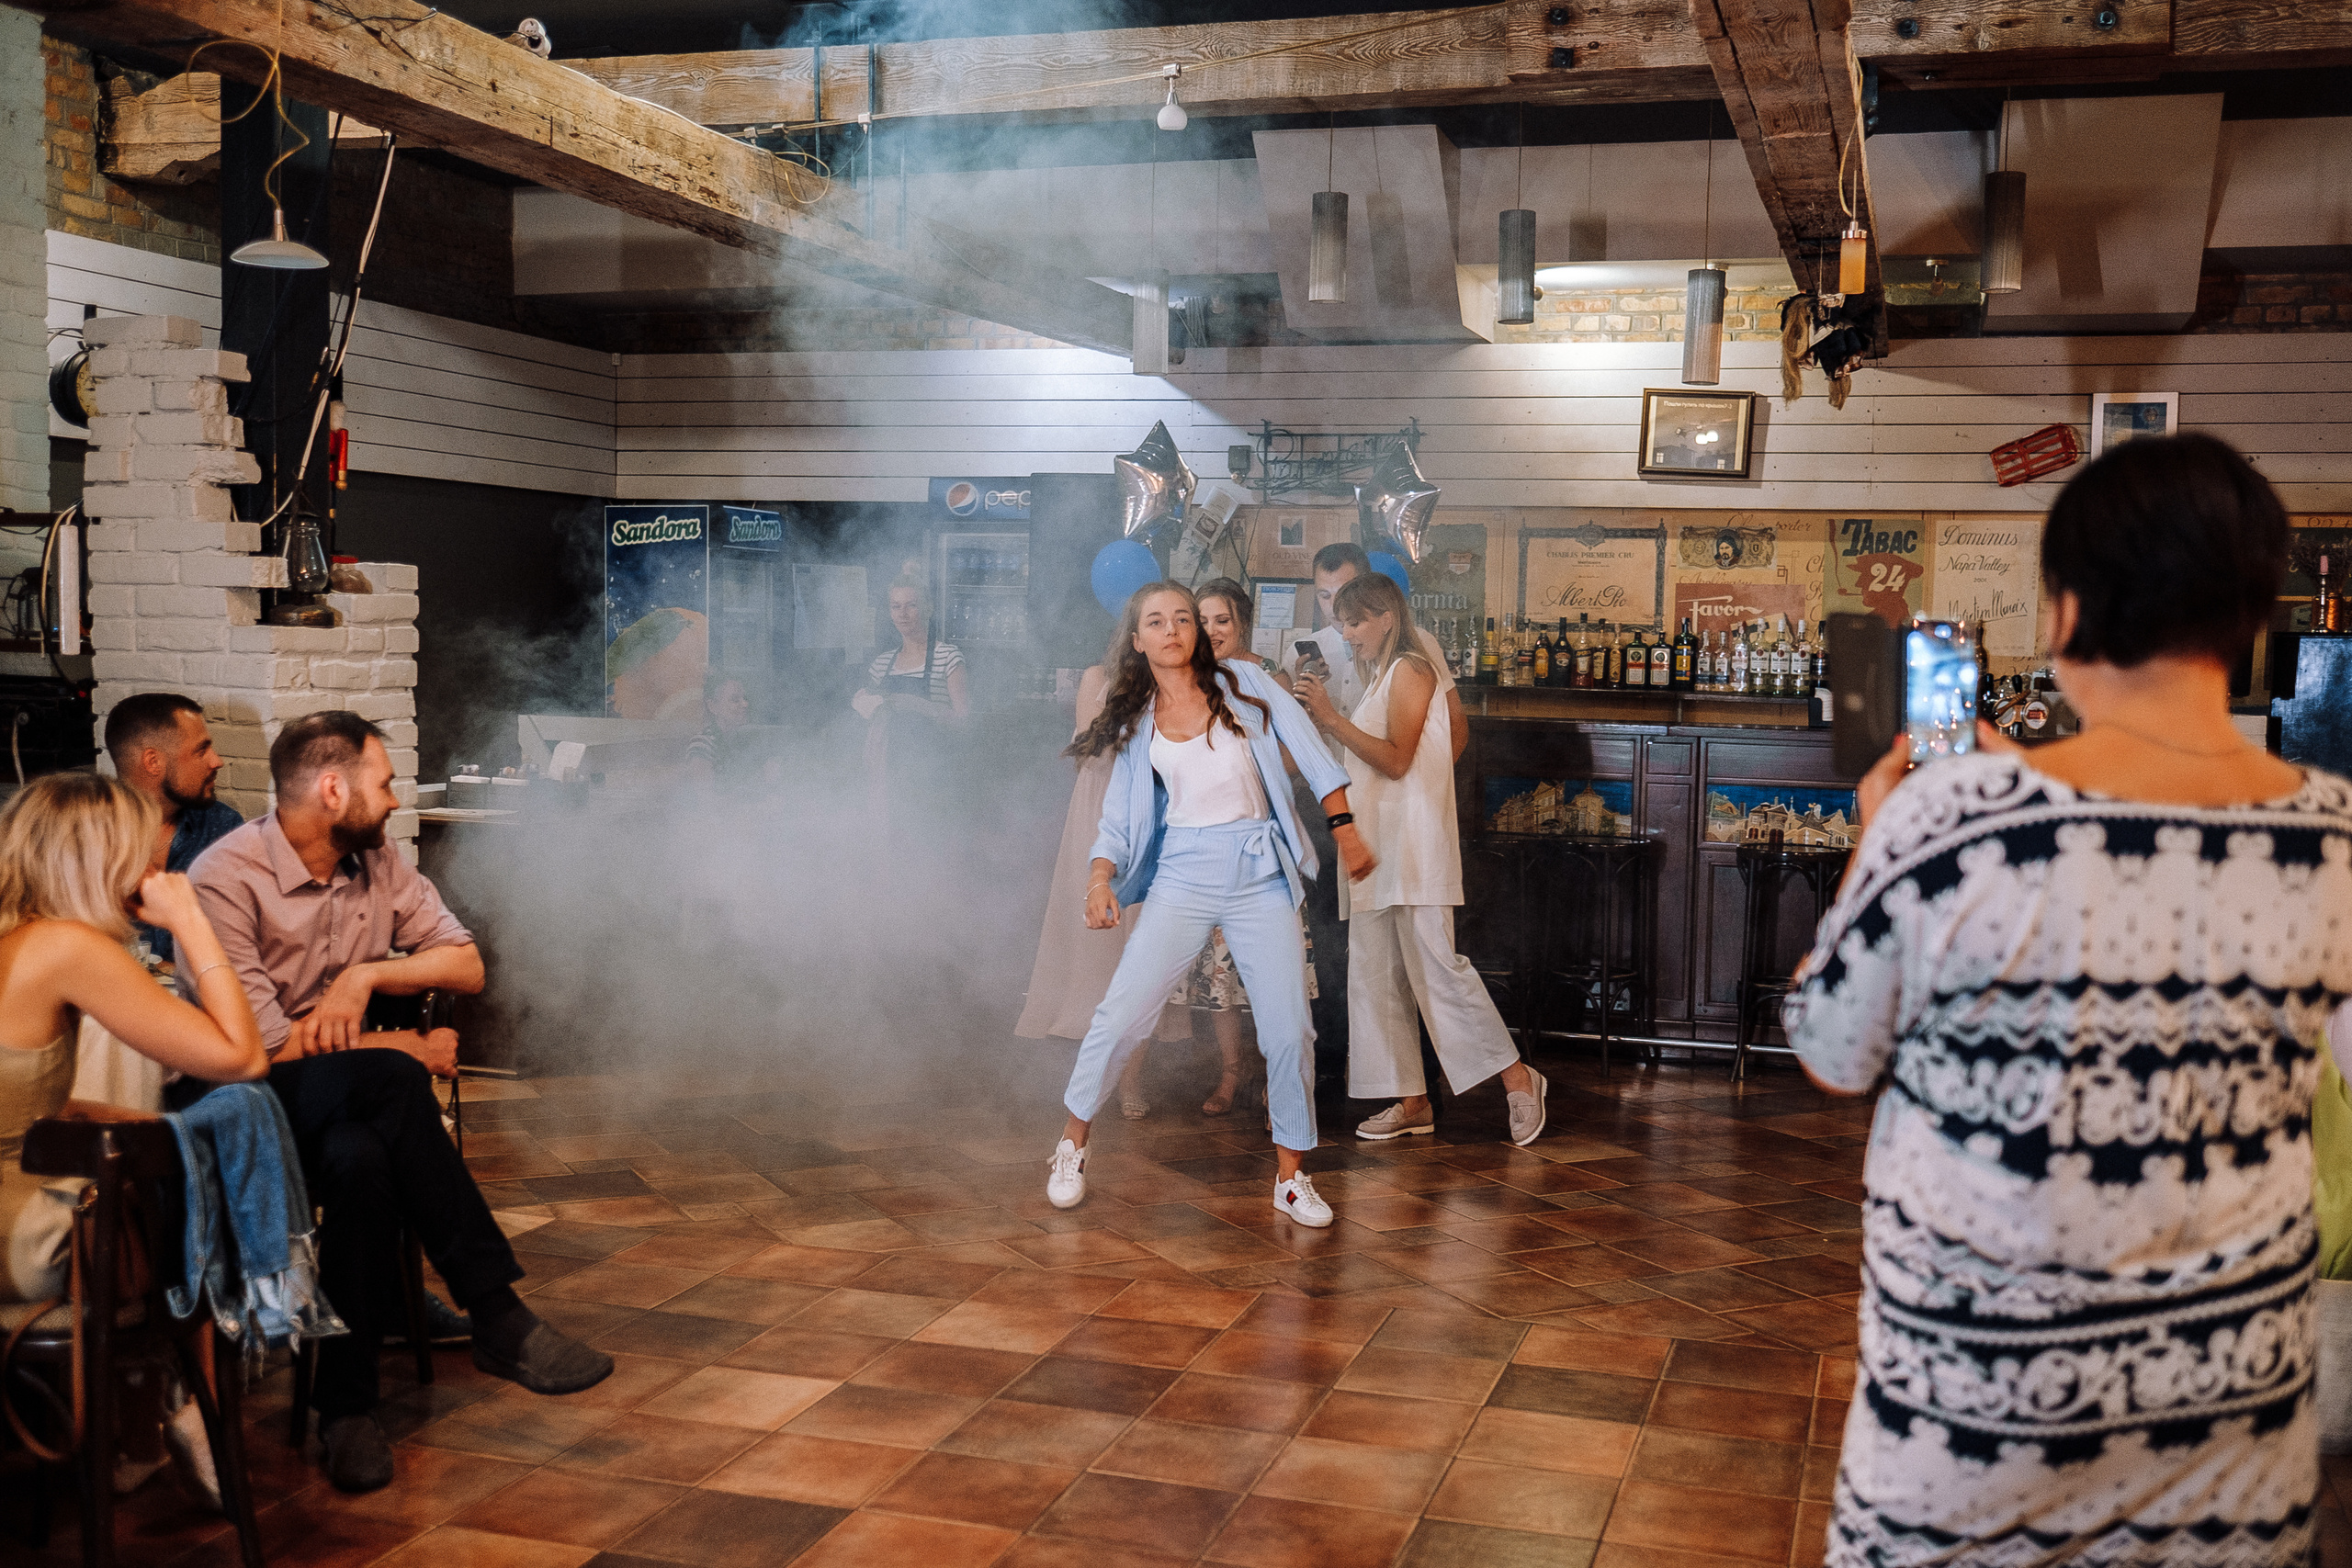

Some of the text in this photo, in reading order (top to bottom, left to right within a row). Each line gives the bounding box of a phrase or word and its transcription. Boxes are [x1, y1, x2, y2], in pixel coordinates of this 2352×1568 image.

[985, 490, 1031, 510] pep
[612, 515, 701, 546] Sandora
[729, 515, 781, 542] Sandora
[1939, 525, 2018, 546] Dominus
[1581, 551, 1615, 559] PREMIER
[1618, 551, 1634, 559] CRU
[1939, 554, 2010, 576] Napa Valley
[1869, 562, 1906, 592] 24
[1410, 592, 1468, 610] ornia
[1541, 581, 1627, 607] Albert Pic
